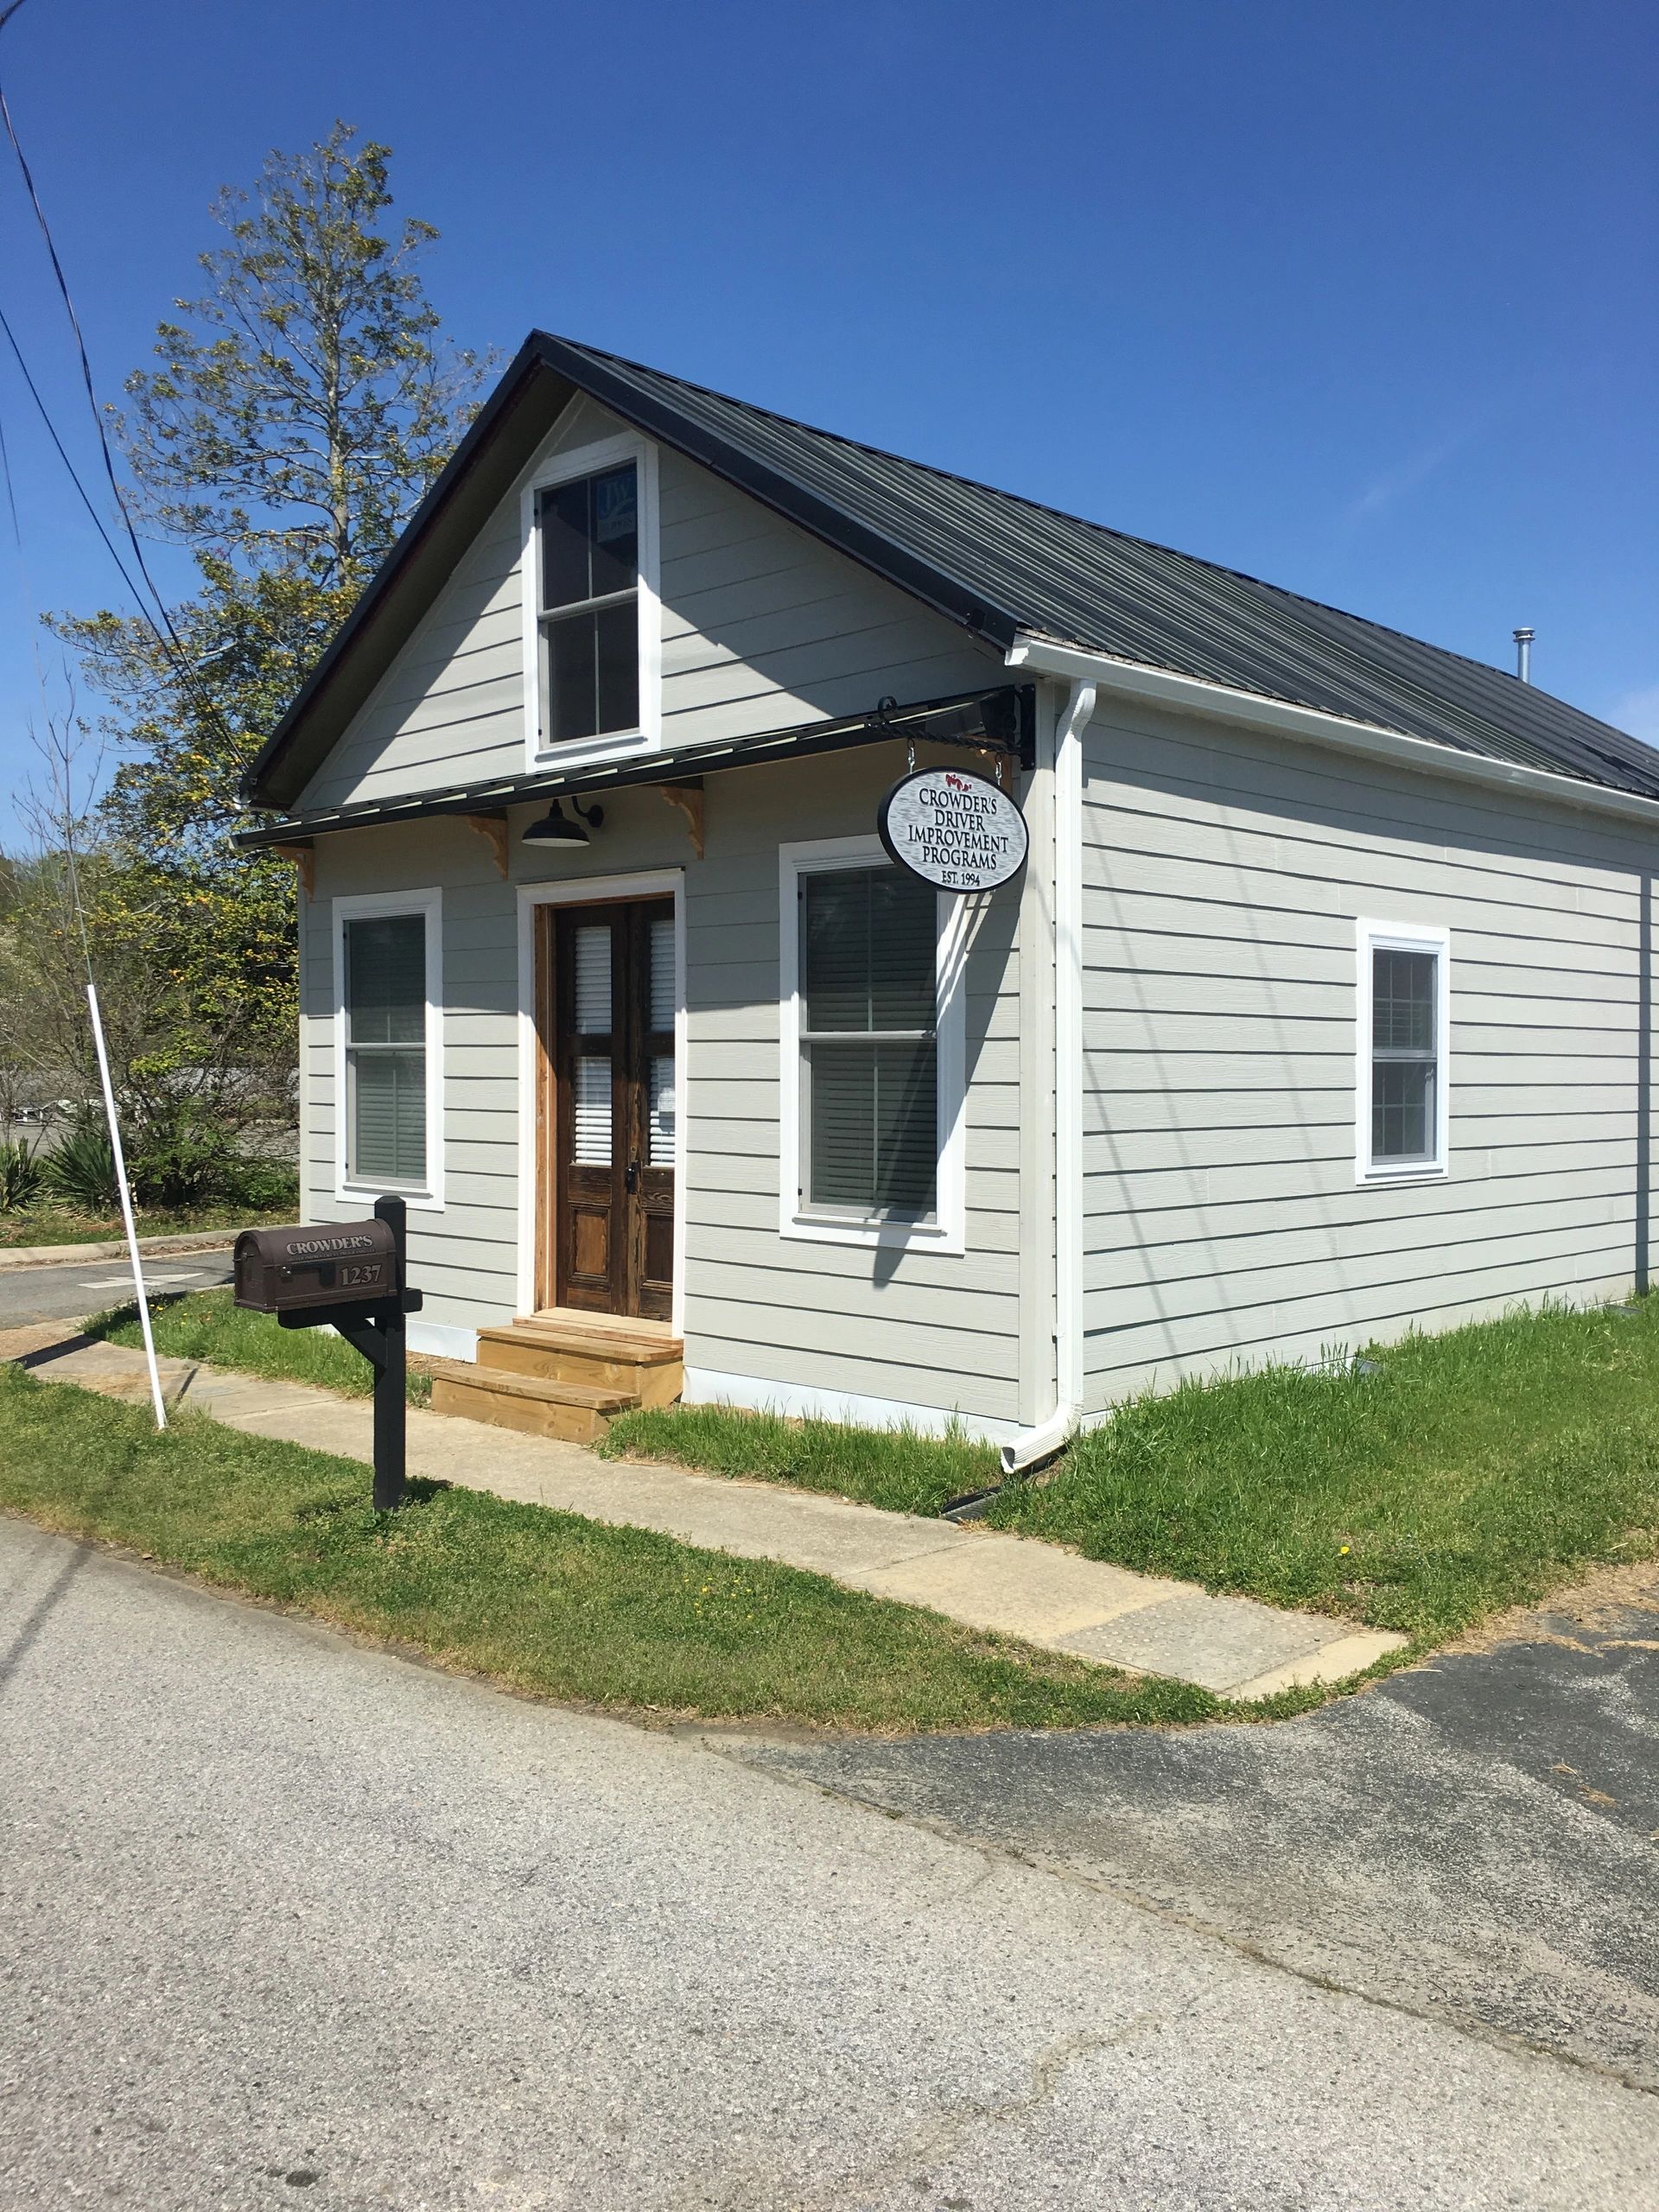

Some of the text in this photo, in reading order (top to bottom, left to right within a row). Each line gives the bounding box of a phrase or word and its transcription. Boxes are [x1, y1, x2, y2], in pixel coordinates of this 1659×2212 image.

[918, 787, 997, 815] CROWDER'S
[934, 809, 986, 832] DRIVER
[908, 824, 1009, 853] IMPROVEMENT
[922, 845, 997, 870] PROGRAMS
[941, 870, 981, 887] EST. 1994
[286, 1235, 373, 1255] CROWDER'S
[340, 1264, 383, 1287] 1237
